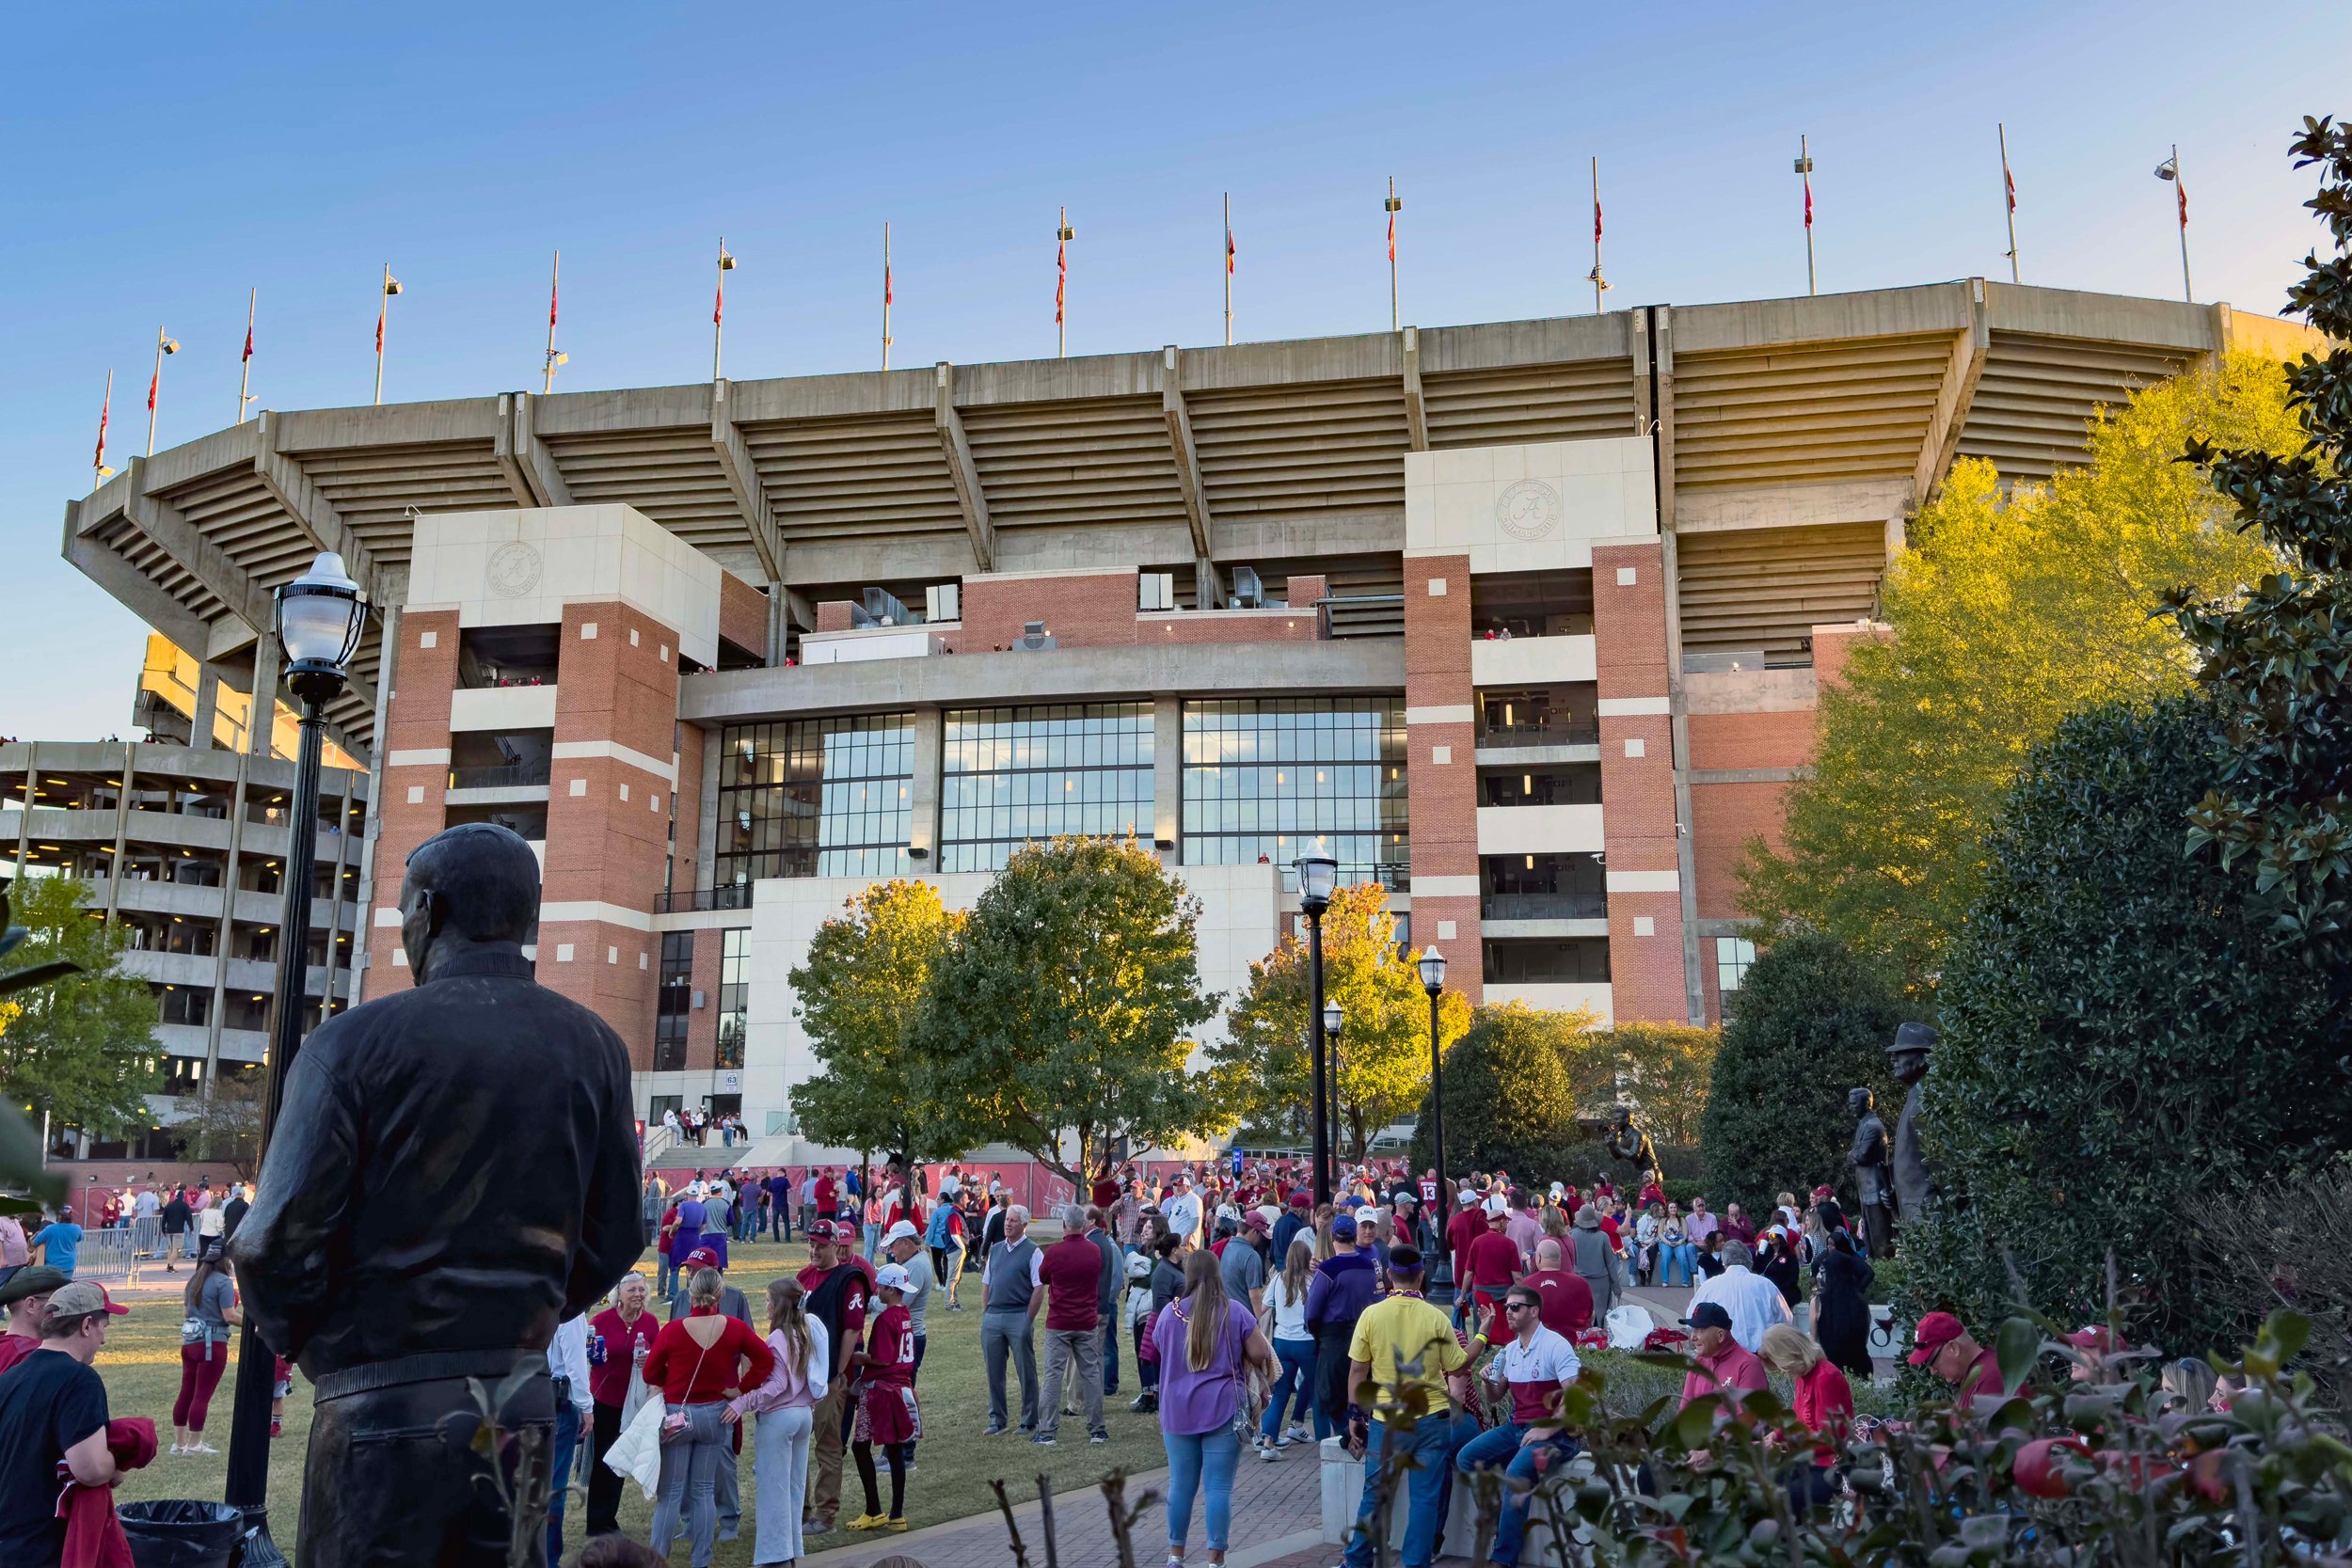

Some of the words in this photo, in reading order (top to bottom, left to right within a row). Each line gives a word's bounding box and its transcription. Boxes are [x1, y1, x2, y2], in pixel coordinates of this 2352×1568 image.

[1501, 483, 1557, 509] ALABAMA
[1502, 515, 1539, 538] CRIMSON
[1541, 515, 1556, 533] TIDE
[492, 546, 540, 568] ALABAMA
[491, 575, 519, 595] CRIMSON
[1422, 1186, 1436, 1200] 13
[1540, 1279, 1557, 1288] ALABAMA
[849, 1293, 863, 1310] A
[896, 1332, 914, 1364] 13
